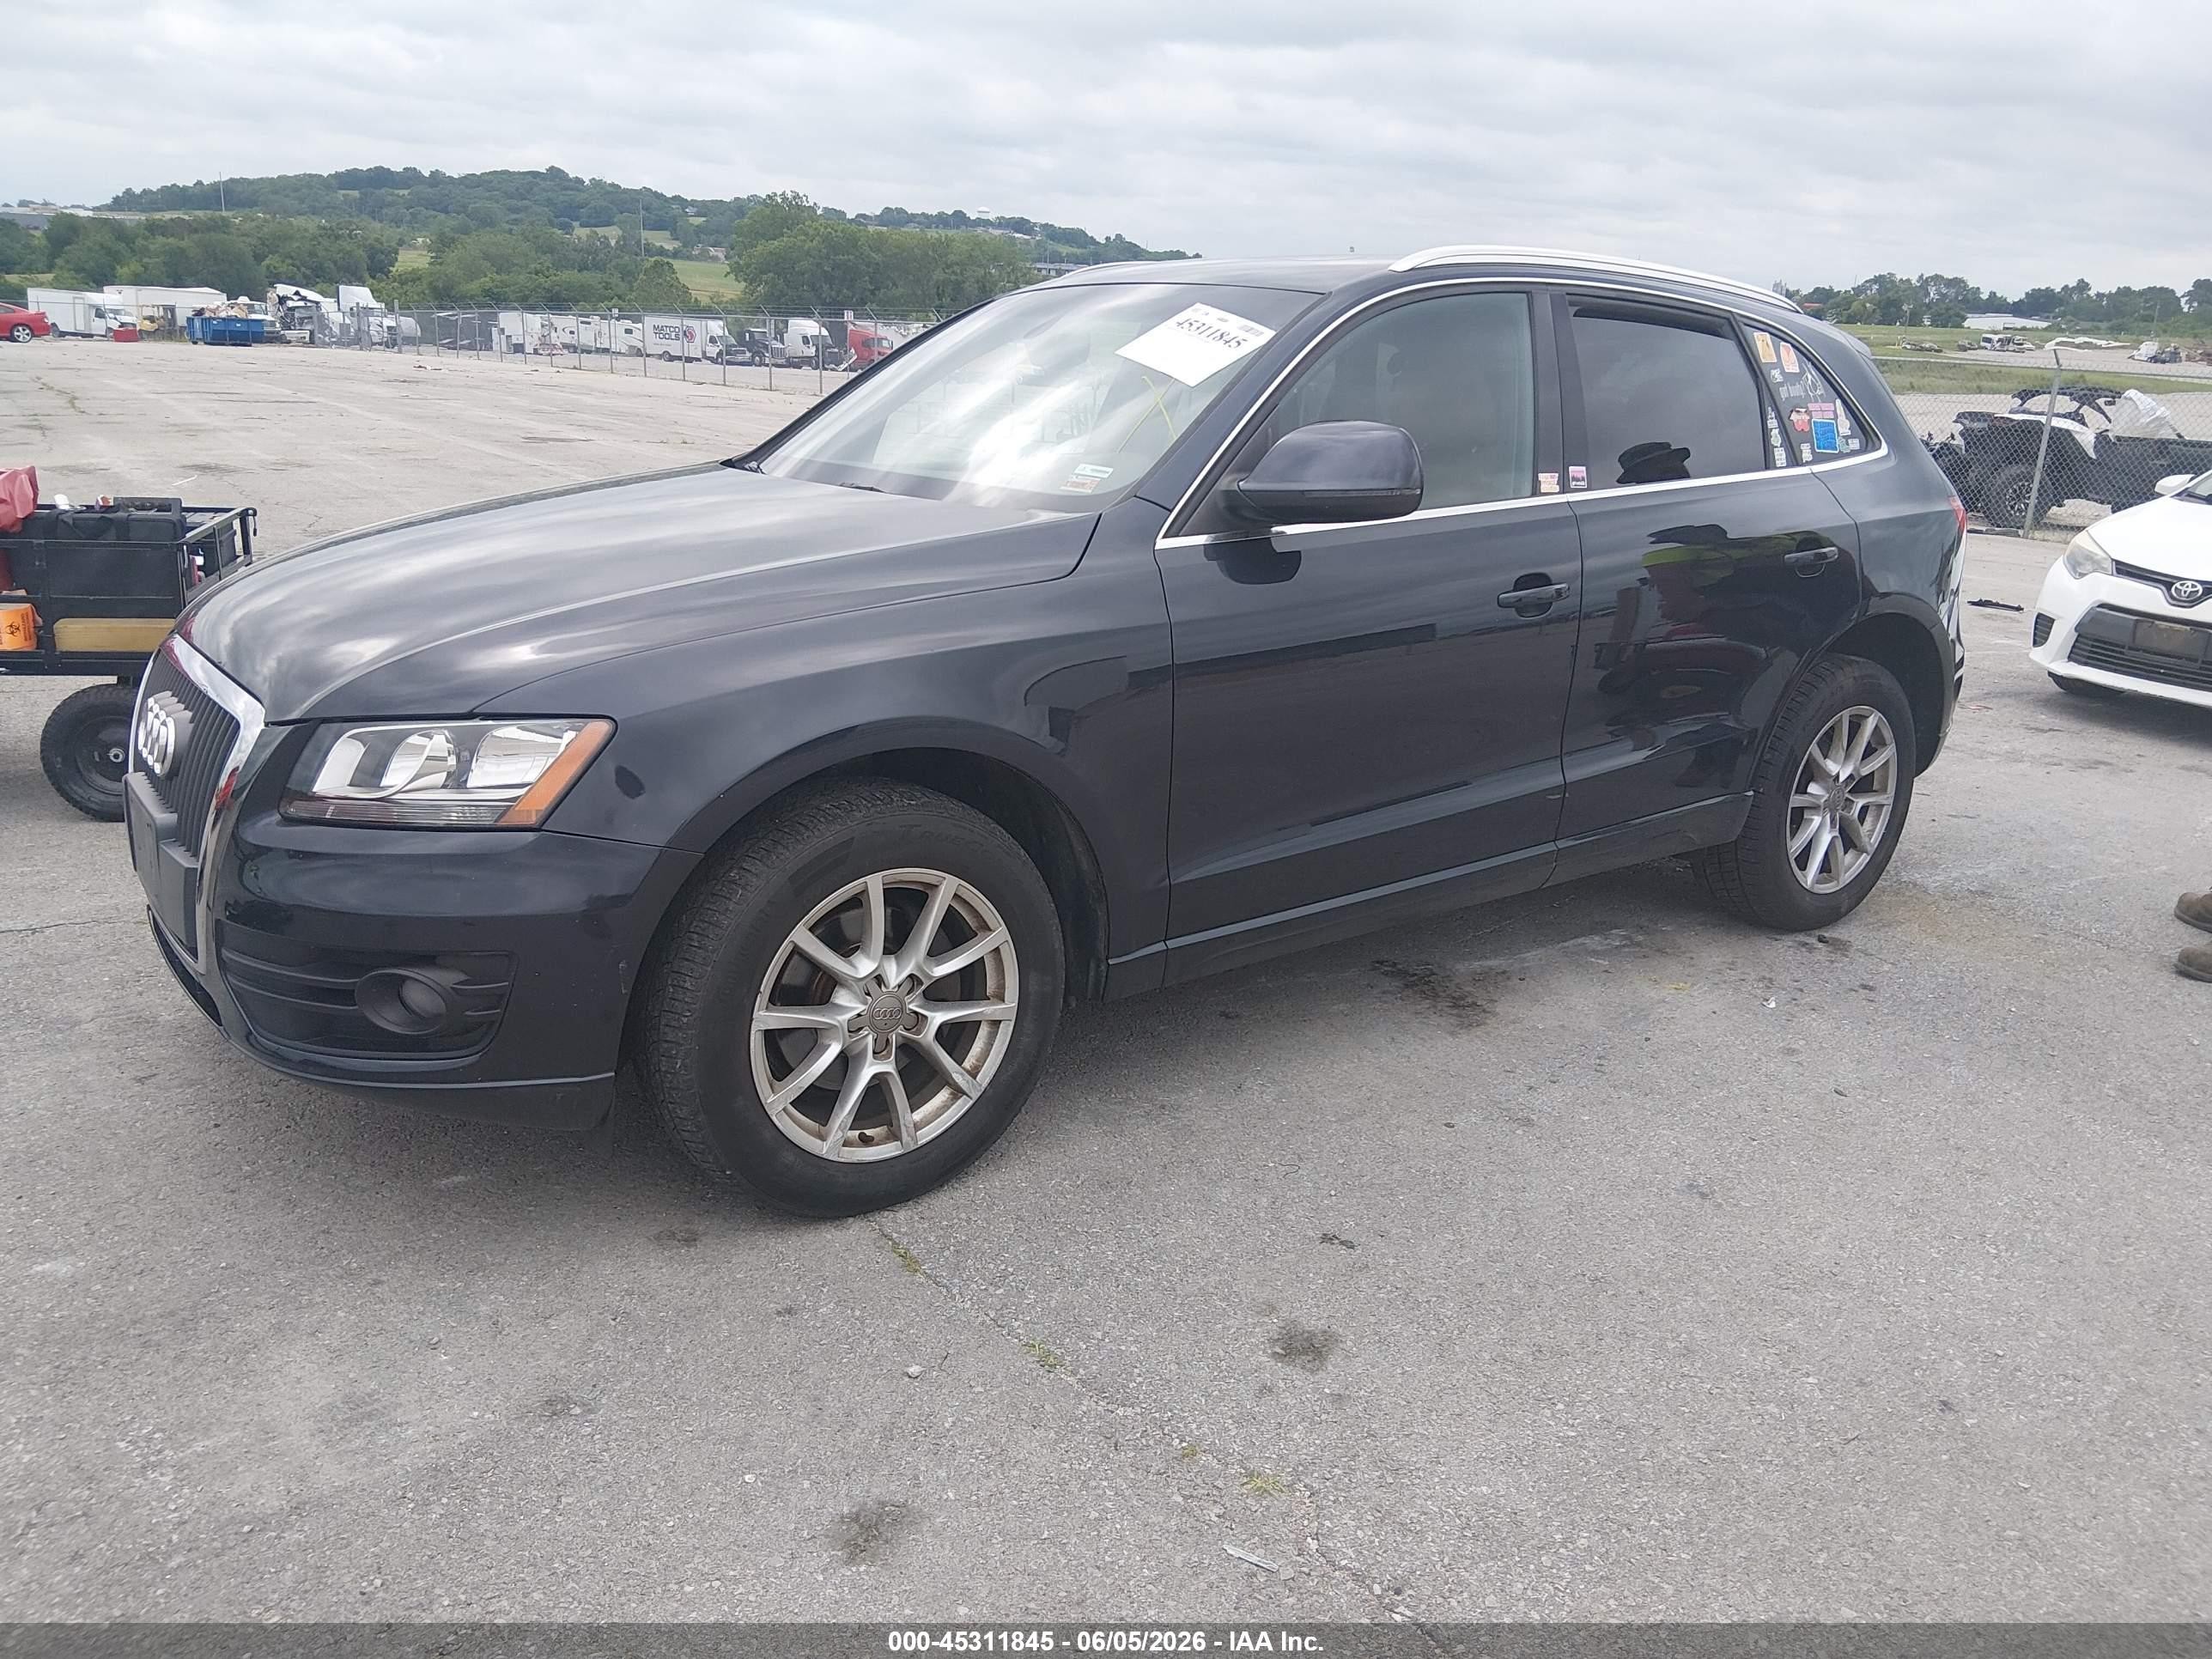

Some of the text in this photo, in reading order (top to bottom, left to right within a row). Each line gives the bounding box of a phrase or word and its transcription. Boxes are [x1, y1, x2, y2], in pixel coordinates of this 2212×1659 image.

[653, 325, 680, 333] MATCO
[1176, 318, 1249, 349] 45311845
[653, 332, 680, 341] TOOLS
